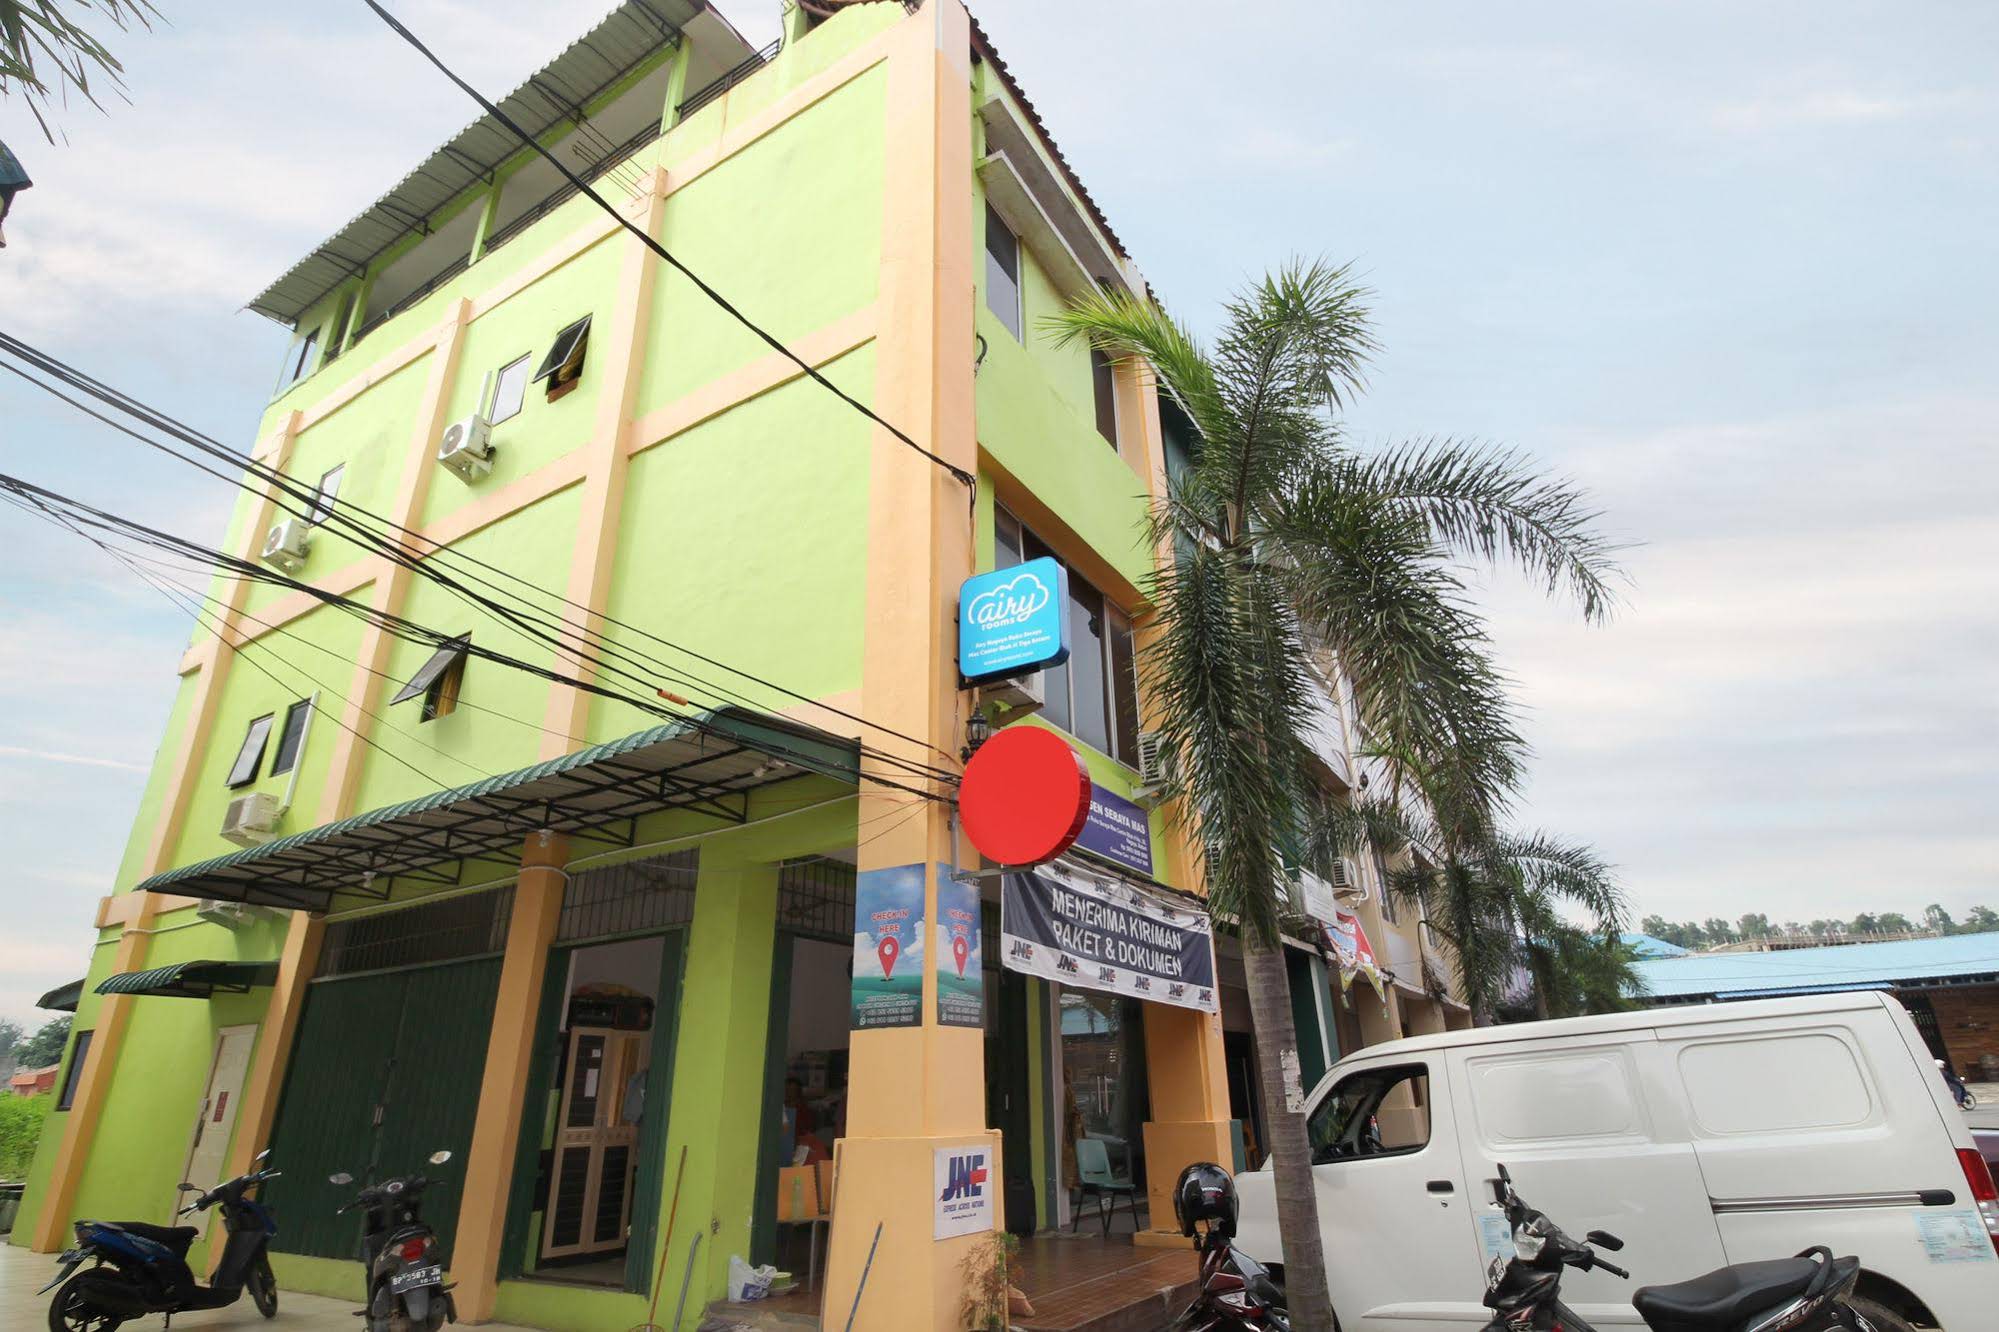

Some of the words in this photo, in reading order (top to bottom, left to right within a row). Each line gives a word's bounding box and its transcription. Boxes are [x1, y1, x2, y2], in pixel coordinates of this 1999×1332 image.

[977, 592, 1035, 623] airy
[982, 616, 1015, 631] rooms
[1104, 807, 1131, 829] SERAYA
[1131, 819, 1146, 835] MAS
[871, 910, 897, 921] CHECK
[1051, 887, 1128, 936] MENERIMA
[1129, 921, 1182, 952] KIRIMAN
[879, 923, 900, 933] HERE
[1011, 940, 1033, 960] JNE
[1052, 920, 1101, 958] PAKET
[1105, 938, 1117, 961] &
[1118, 941, 1182, 977] DOKUMEN
[1057, 954, 1078, 972] JNE
[1098, 966, 1116, 983] JNE
[1134, 974, 1152, 991] JNE
[1168, 982, 1184, 997] JNE
[1198, 988, 1212, 1002] JNE
[940, 1155, 987, 1201] JNE
